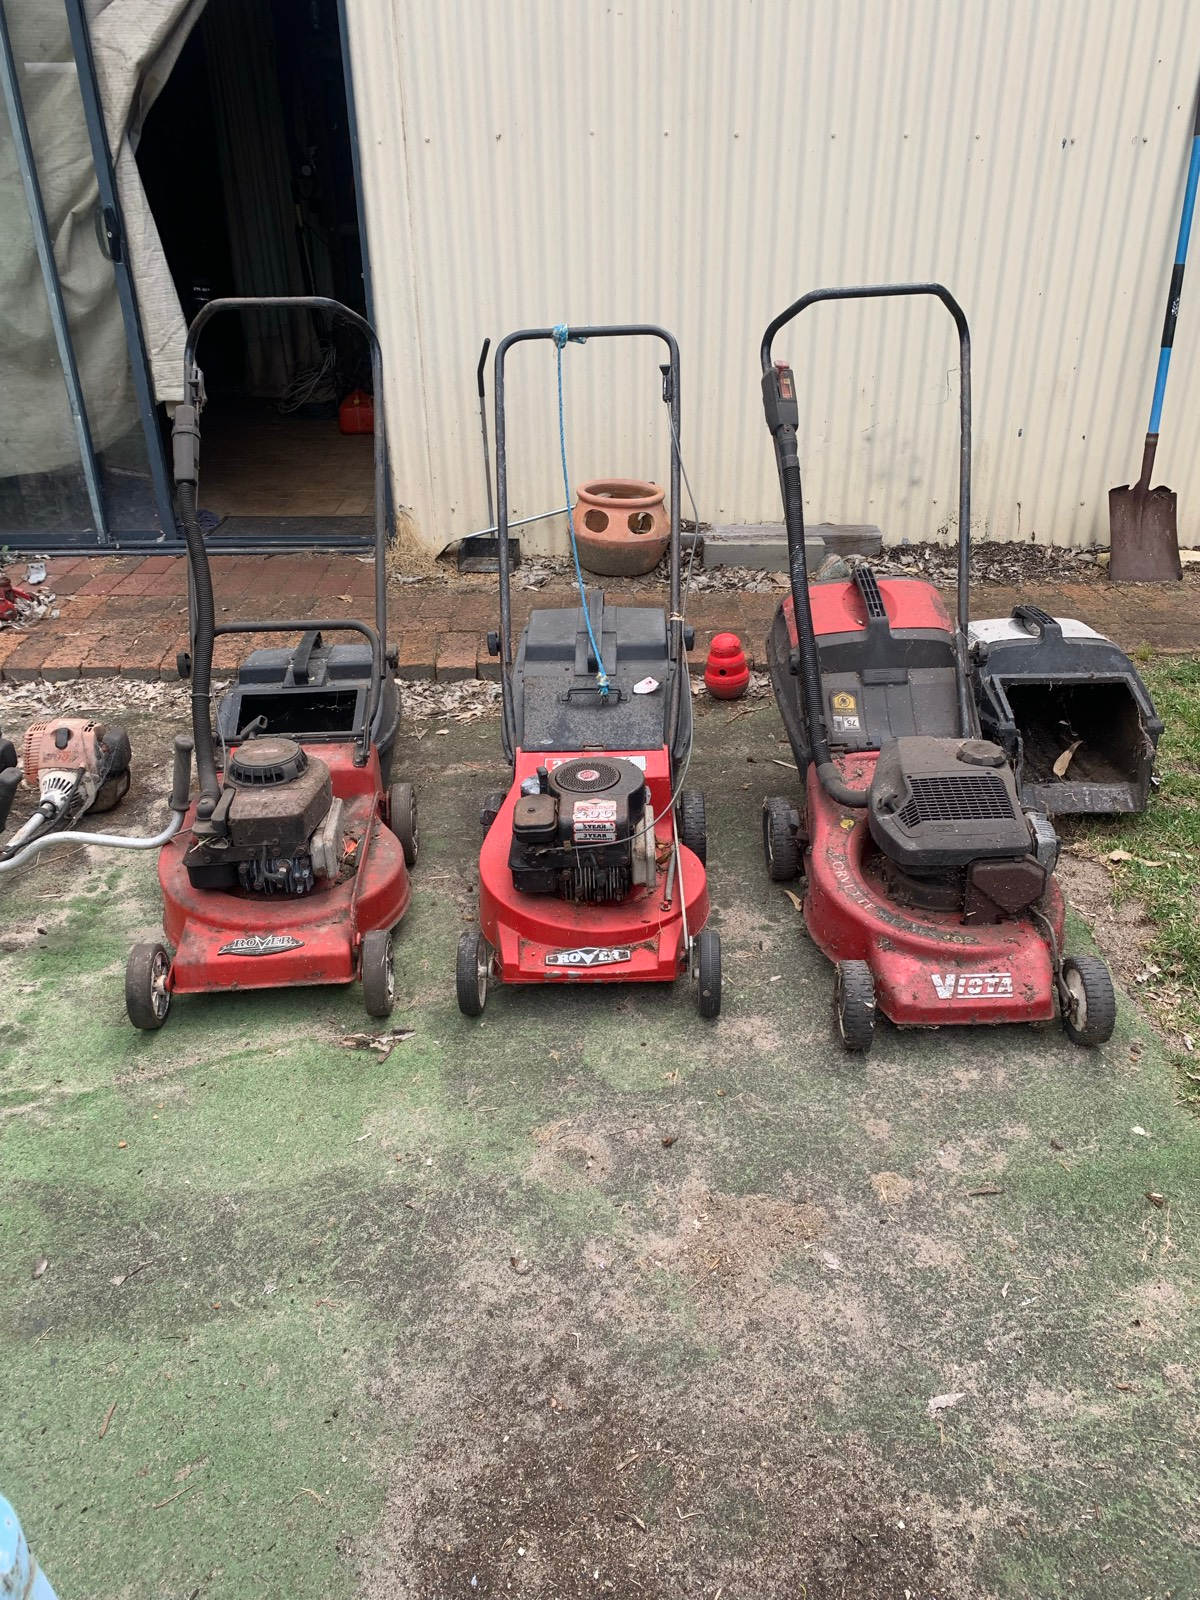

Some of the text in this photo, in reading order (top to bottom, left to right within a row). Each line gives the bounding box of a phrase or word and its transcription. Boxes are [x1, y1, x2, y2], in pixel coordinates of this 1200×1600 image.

[232, 934, 294, 950] ROVER
[556, 946, 620, 965] ROVER
[930, 973, 1013, 1000] VICTA
